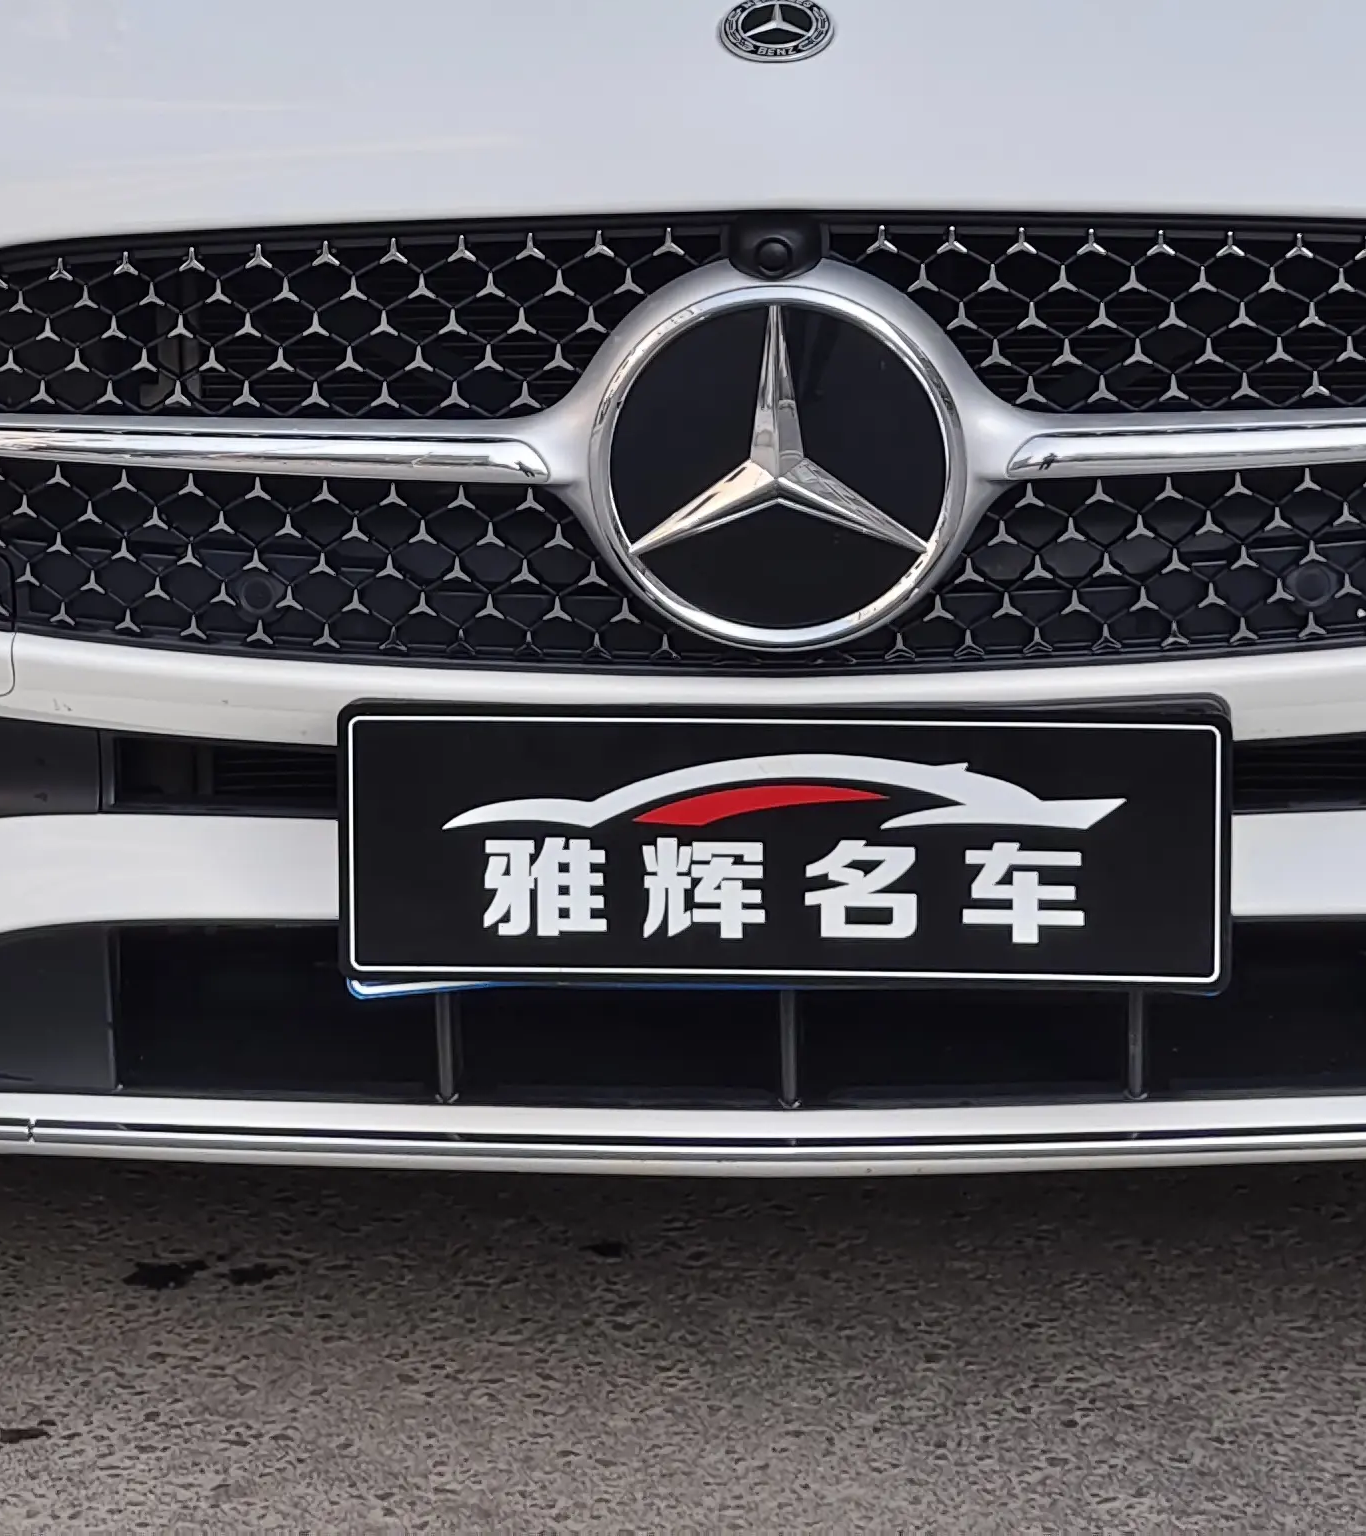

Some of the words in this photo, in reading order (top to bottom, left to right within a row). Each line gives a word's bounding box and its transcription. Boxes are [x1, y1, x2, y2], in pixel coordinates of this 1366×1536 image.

[756, 46, 797, 56] BENZ
[483, 836, 1085, 945] 雅辉名车
